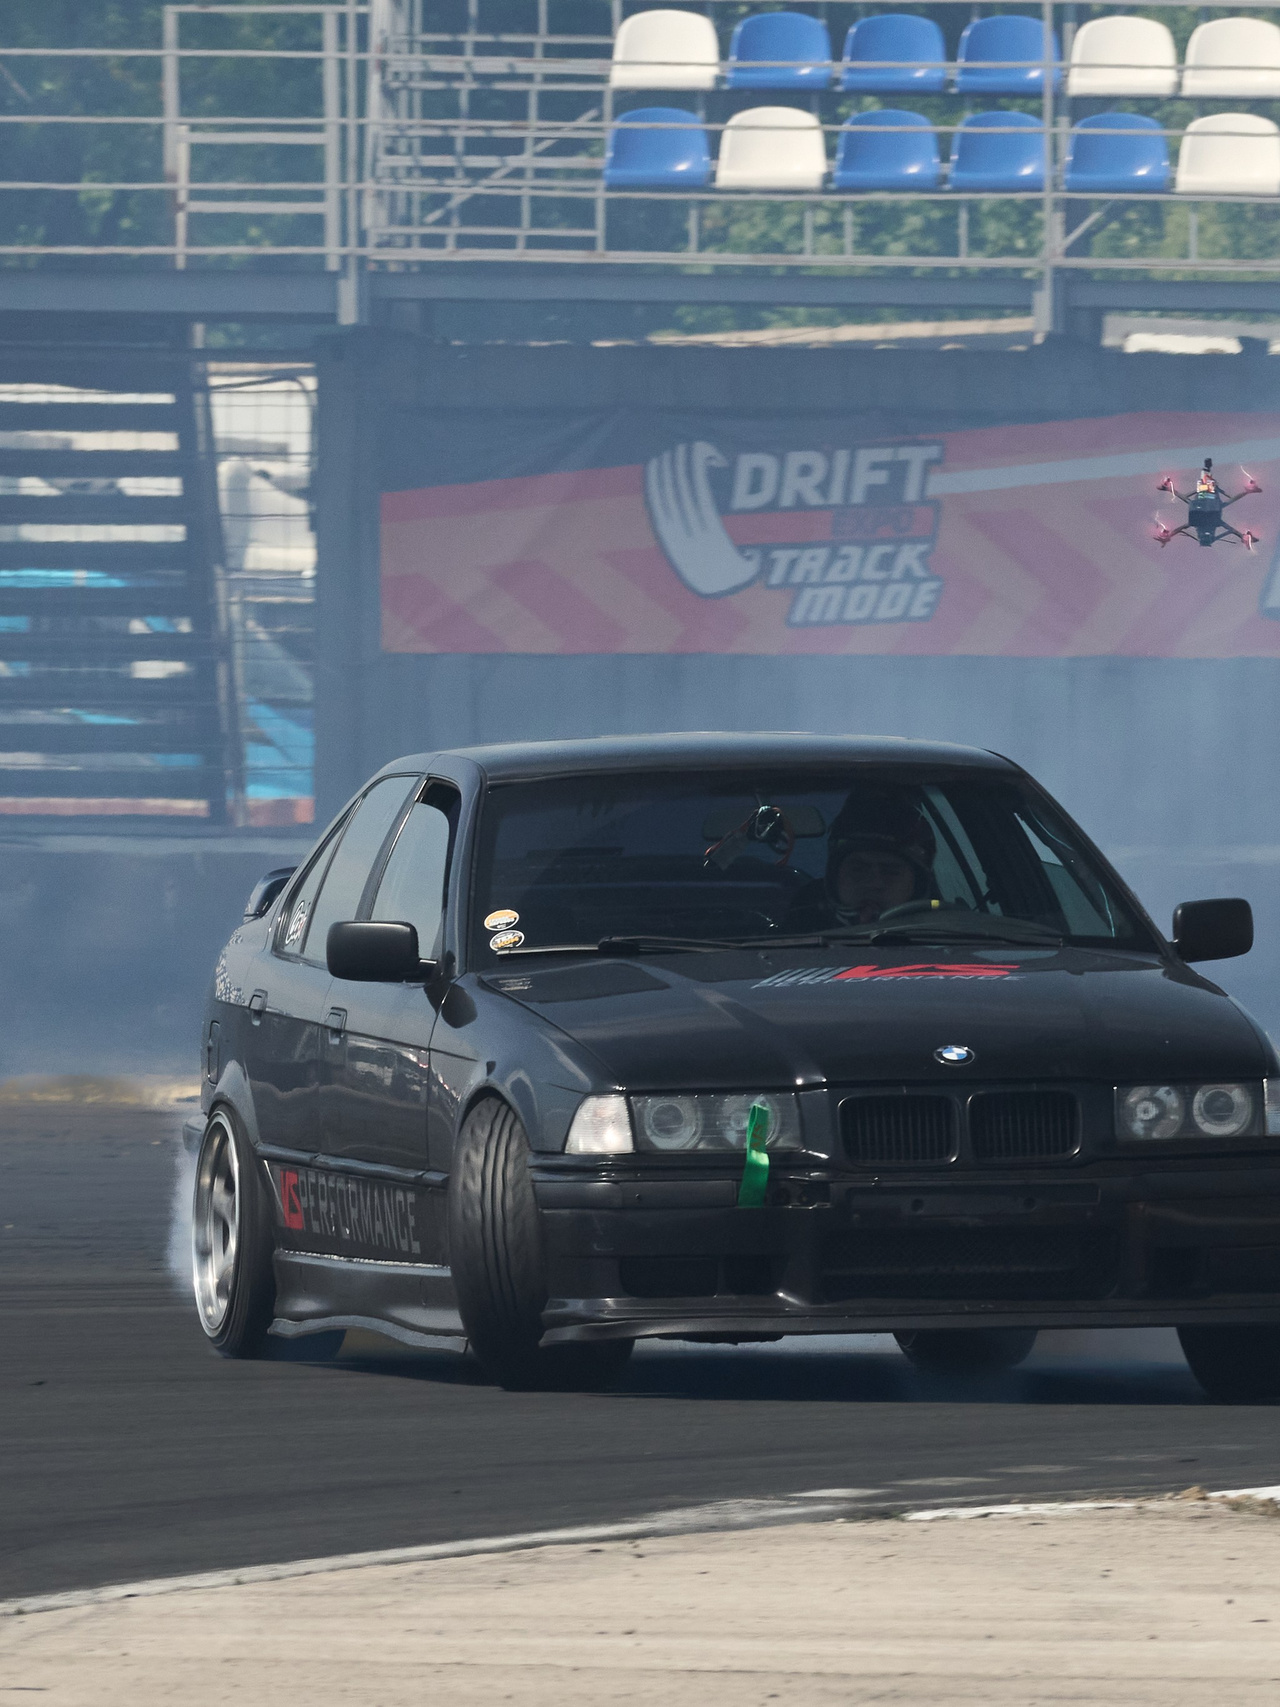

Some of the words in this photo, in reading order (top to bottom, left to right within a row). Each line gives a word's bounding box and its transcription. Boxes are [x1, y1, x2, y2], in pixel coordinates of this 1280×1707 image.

[731, 445, 942, 510] DRIFT
[790, 581, 943, 624] MODE
[832, 964, 1021, 979] VS
[299, 1170, 421, 1254] PERFORMANCE
